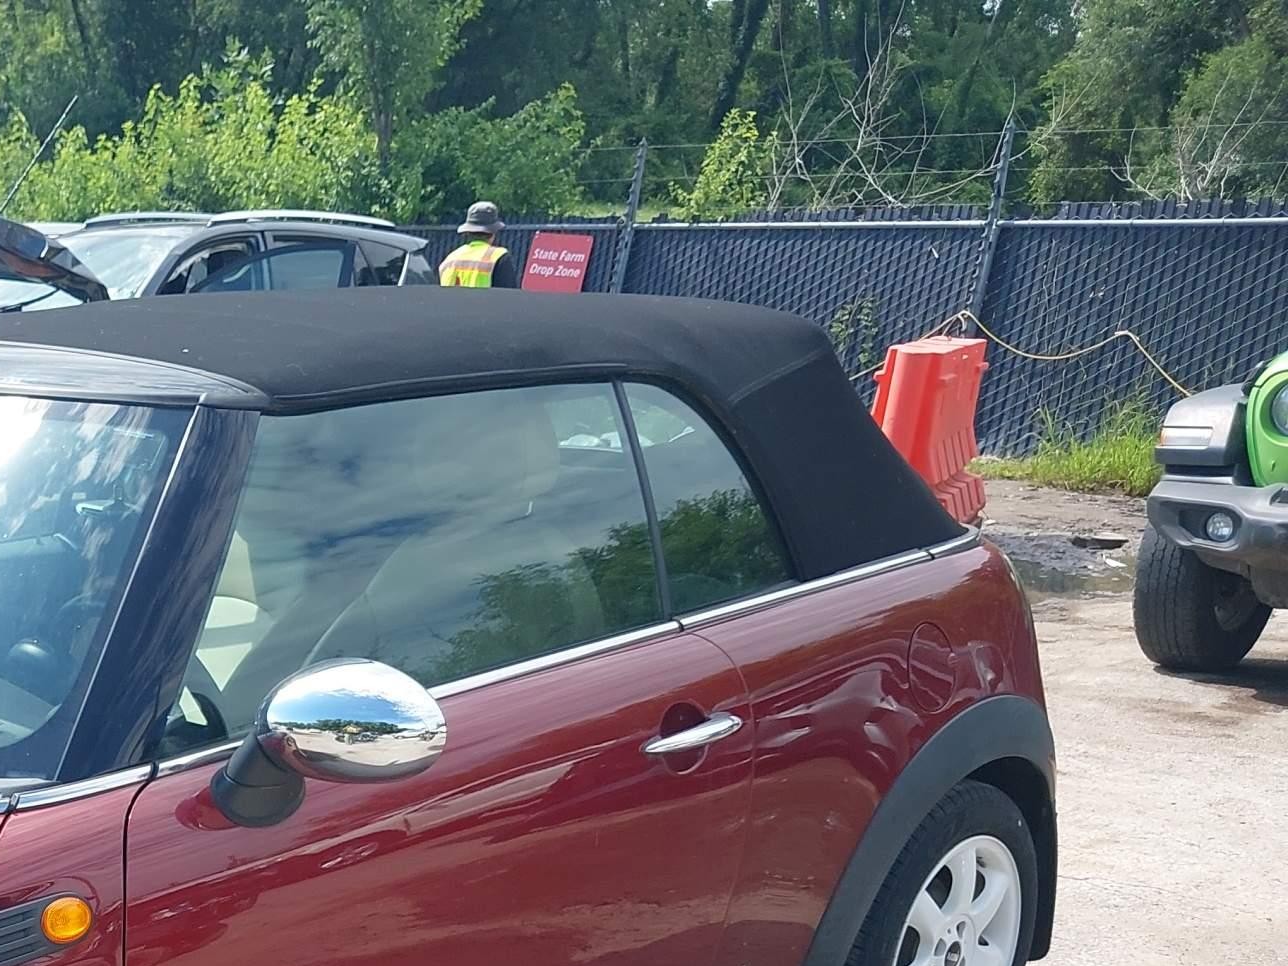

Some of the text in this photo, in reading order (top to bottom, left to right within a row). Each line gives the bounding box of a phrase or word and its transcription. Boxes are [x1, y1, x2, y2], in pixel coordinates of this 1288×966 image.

[532, 248, 585, 262] State Farm
[529, 263, 581, 278] Drop Zone
